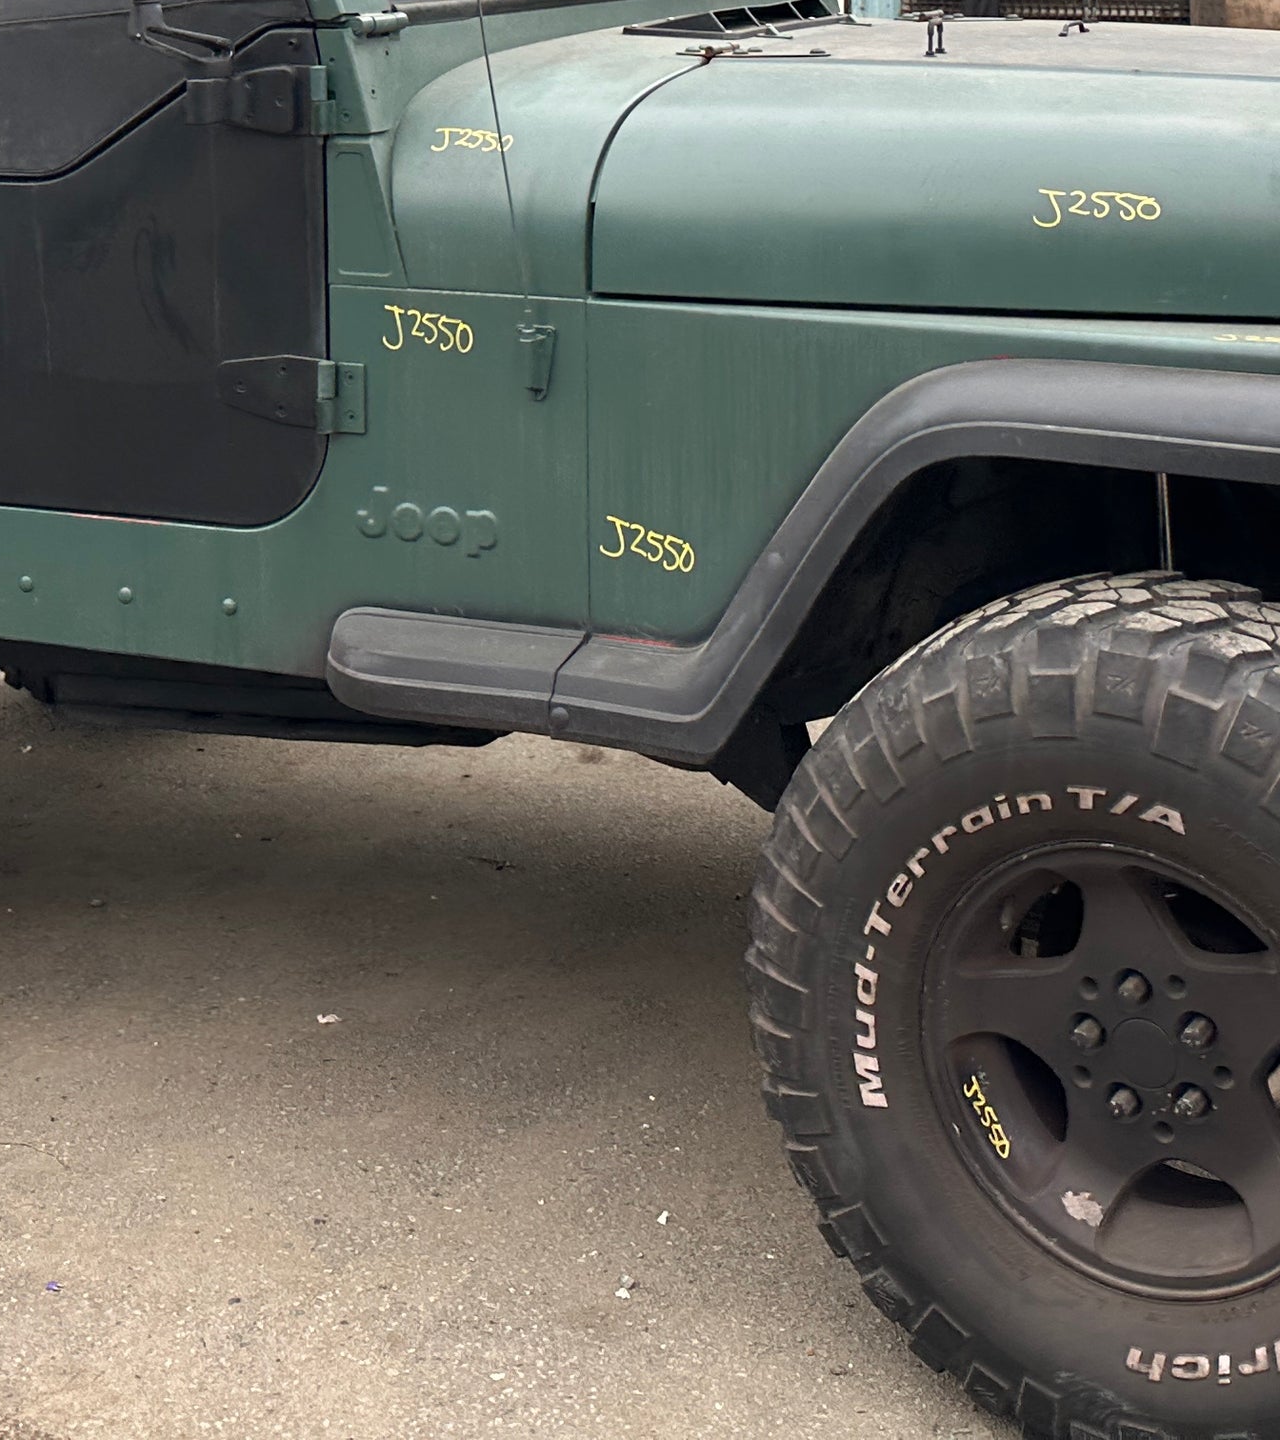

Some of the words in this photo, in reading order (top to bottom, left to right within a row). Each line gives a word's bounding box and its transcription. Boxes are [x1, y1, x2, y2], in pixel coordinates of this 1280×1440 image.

[430, 127, 514, 153] J2550
[1032, 188, 1162, 229] J2550
[382, 304, 474, 354] J2550
[599, 515, 696, 573] J2550
[851, 790, 1055, 1109] Mud-Terrain
[1065, 785, 1187, 836] T/A
[963, 1075, 1010, 1159] J2550
